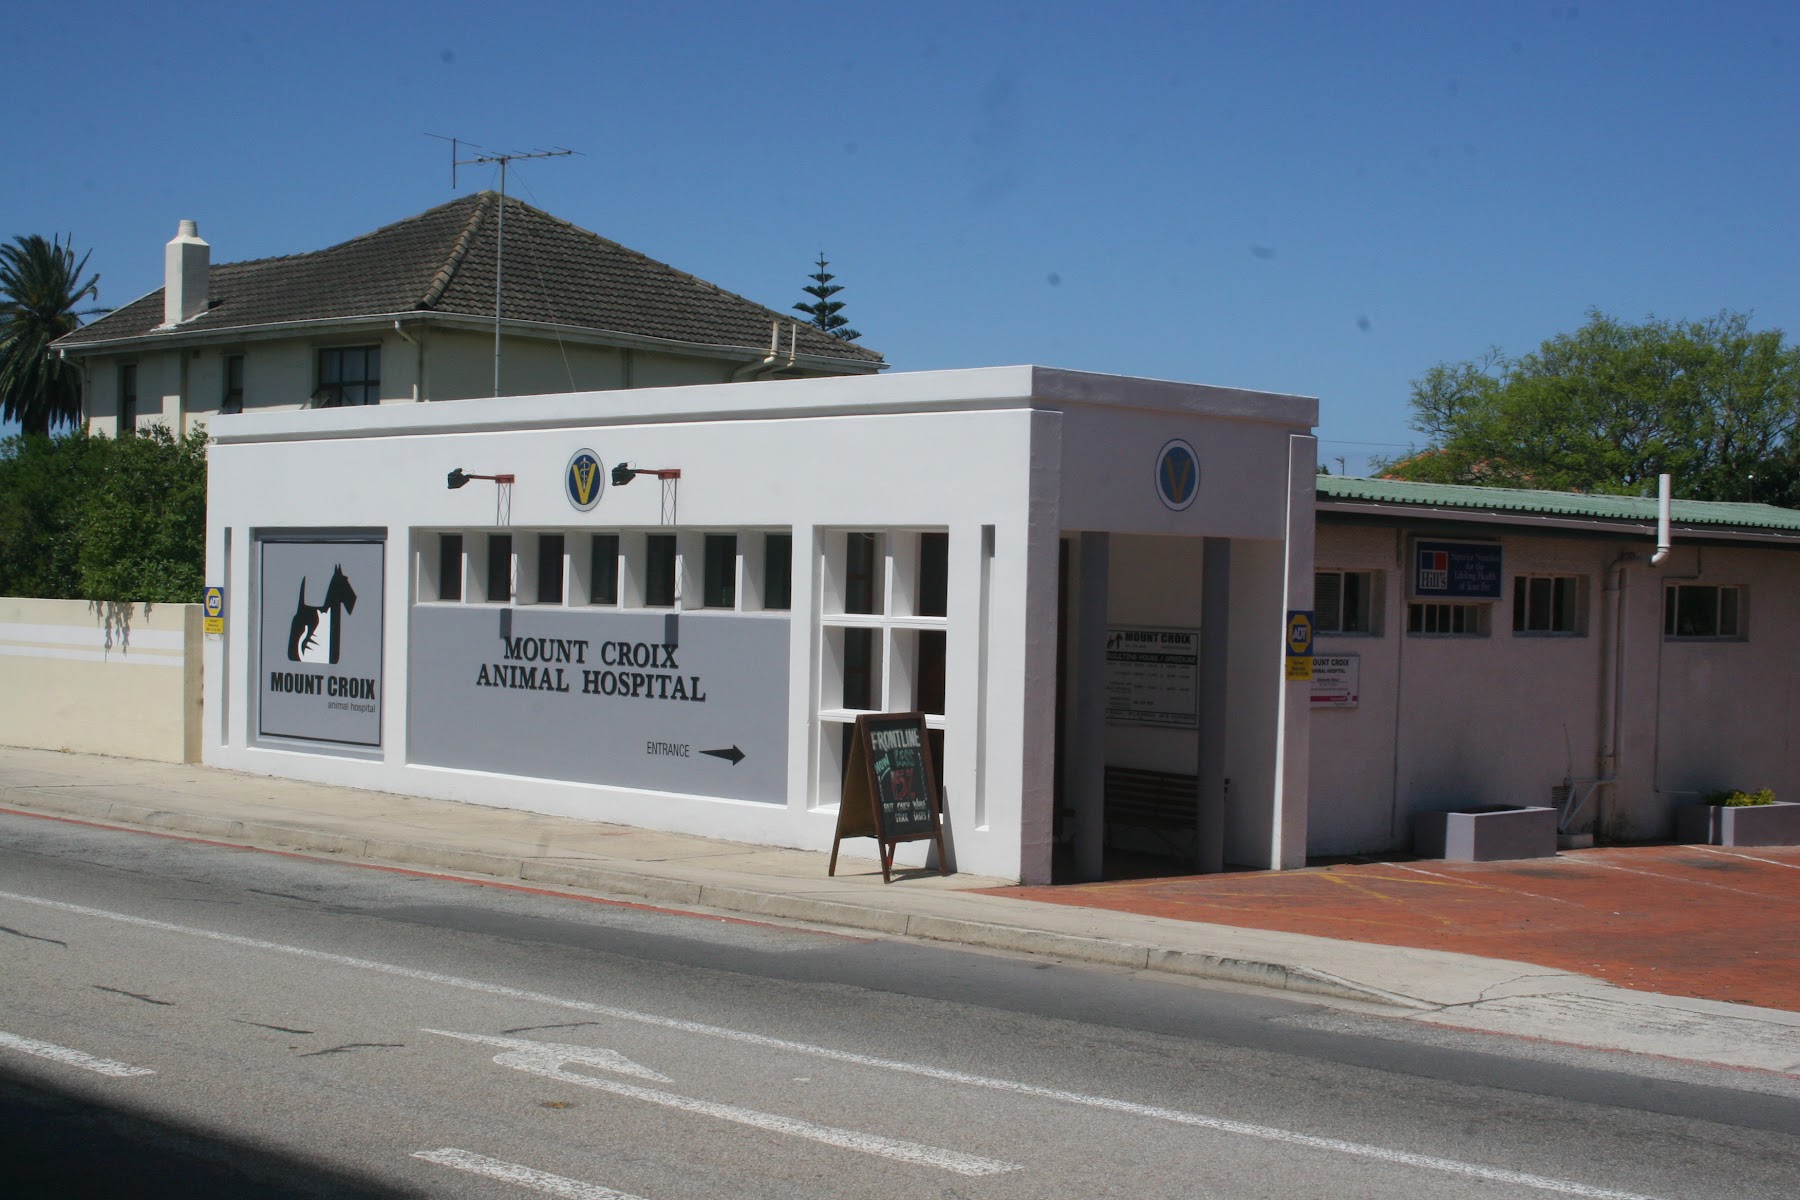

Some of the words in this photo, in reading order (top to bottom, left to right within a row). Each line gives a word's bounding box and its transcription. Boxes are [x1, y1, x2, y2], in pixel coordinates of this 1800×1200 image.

[1421, 571, 1447, 588] Hill's
[209, 597, 219, 607] ADT
[1125, 632, 1160, 643] MOUNT
[1161, 633, 1191, 644] CROIX
[1292, 627, 1307, 640] ADT
[503, 636, 589, 664] MOUNT
[601, 641, 679, 669] CROIX
[1312, 658, 1330, 666] OUNT
[1331, 658, 1350, 666] CROIX
[270, 672, 324, 695] MOUNT
[327, 675, 376, 700] CROIX
[476, 663, 570, 693] ANIMAL
[582, 670, 706, 702] HOSPITAL
[327, 700, 349, 711] animal
[350, 702, 376, 714] hospital
[871, 728, 921, 752] FRONTLINE
[646, 741, 690, 758] ENTRANCE
